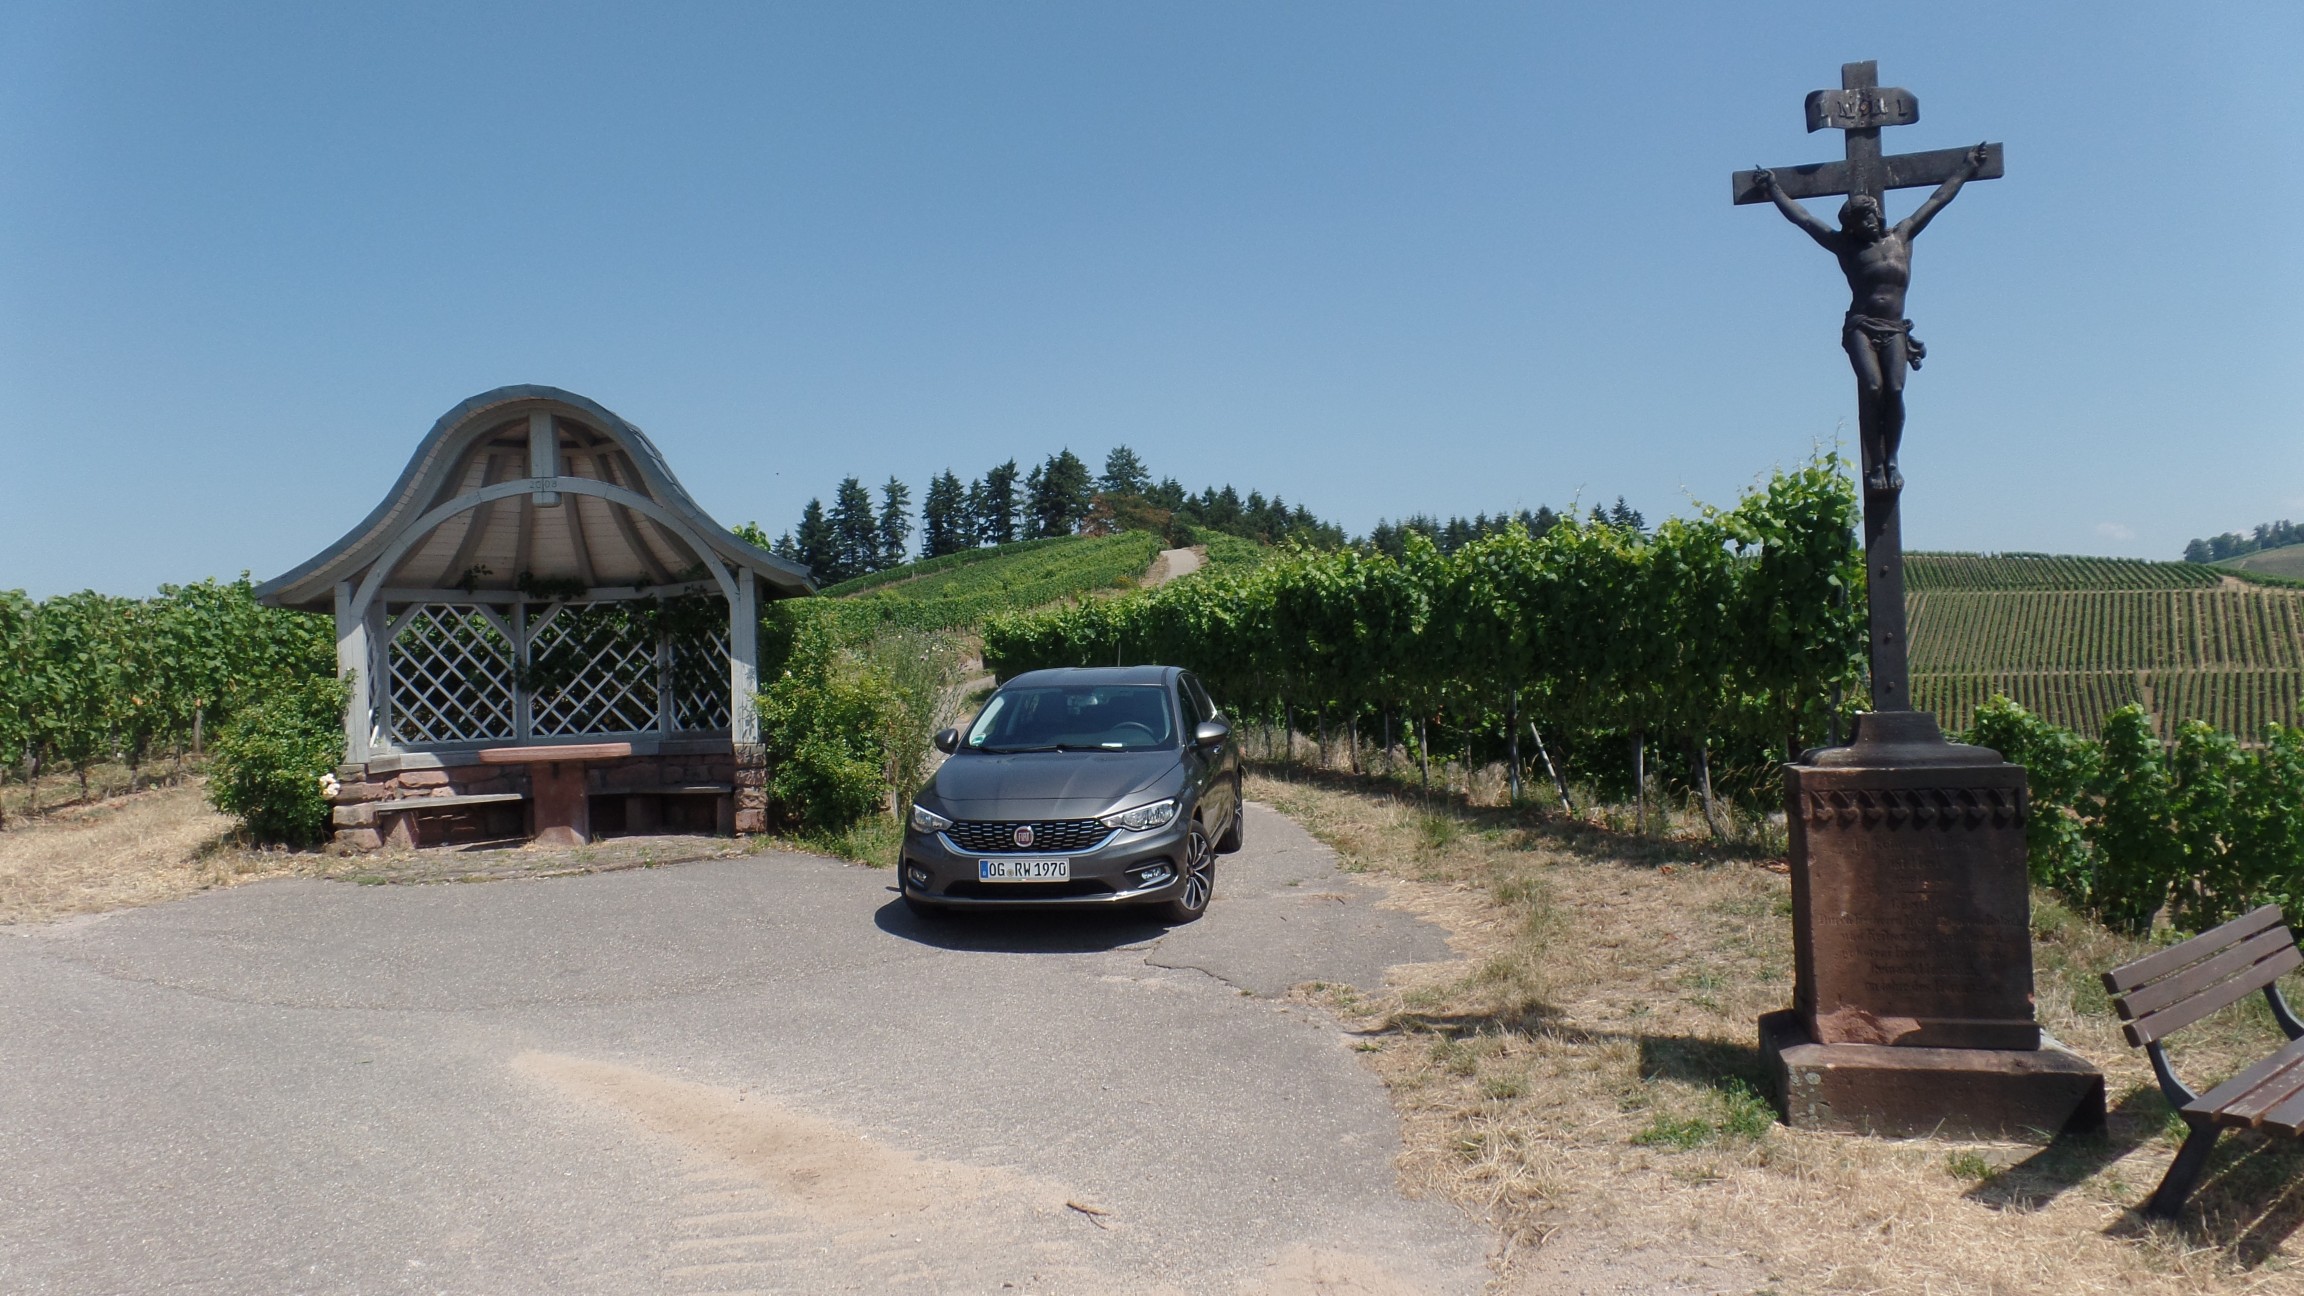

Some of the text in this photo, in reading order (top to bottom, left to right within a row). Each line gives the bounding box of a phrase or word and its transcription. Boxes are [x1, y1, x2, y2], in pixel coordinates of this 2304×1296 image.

[529, 480, 558, 489] 2008
[989, 862, 1067, 877] OG RW 1970
